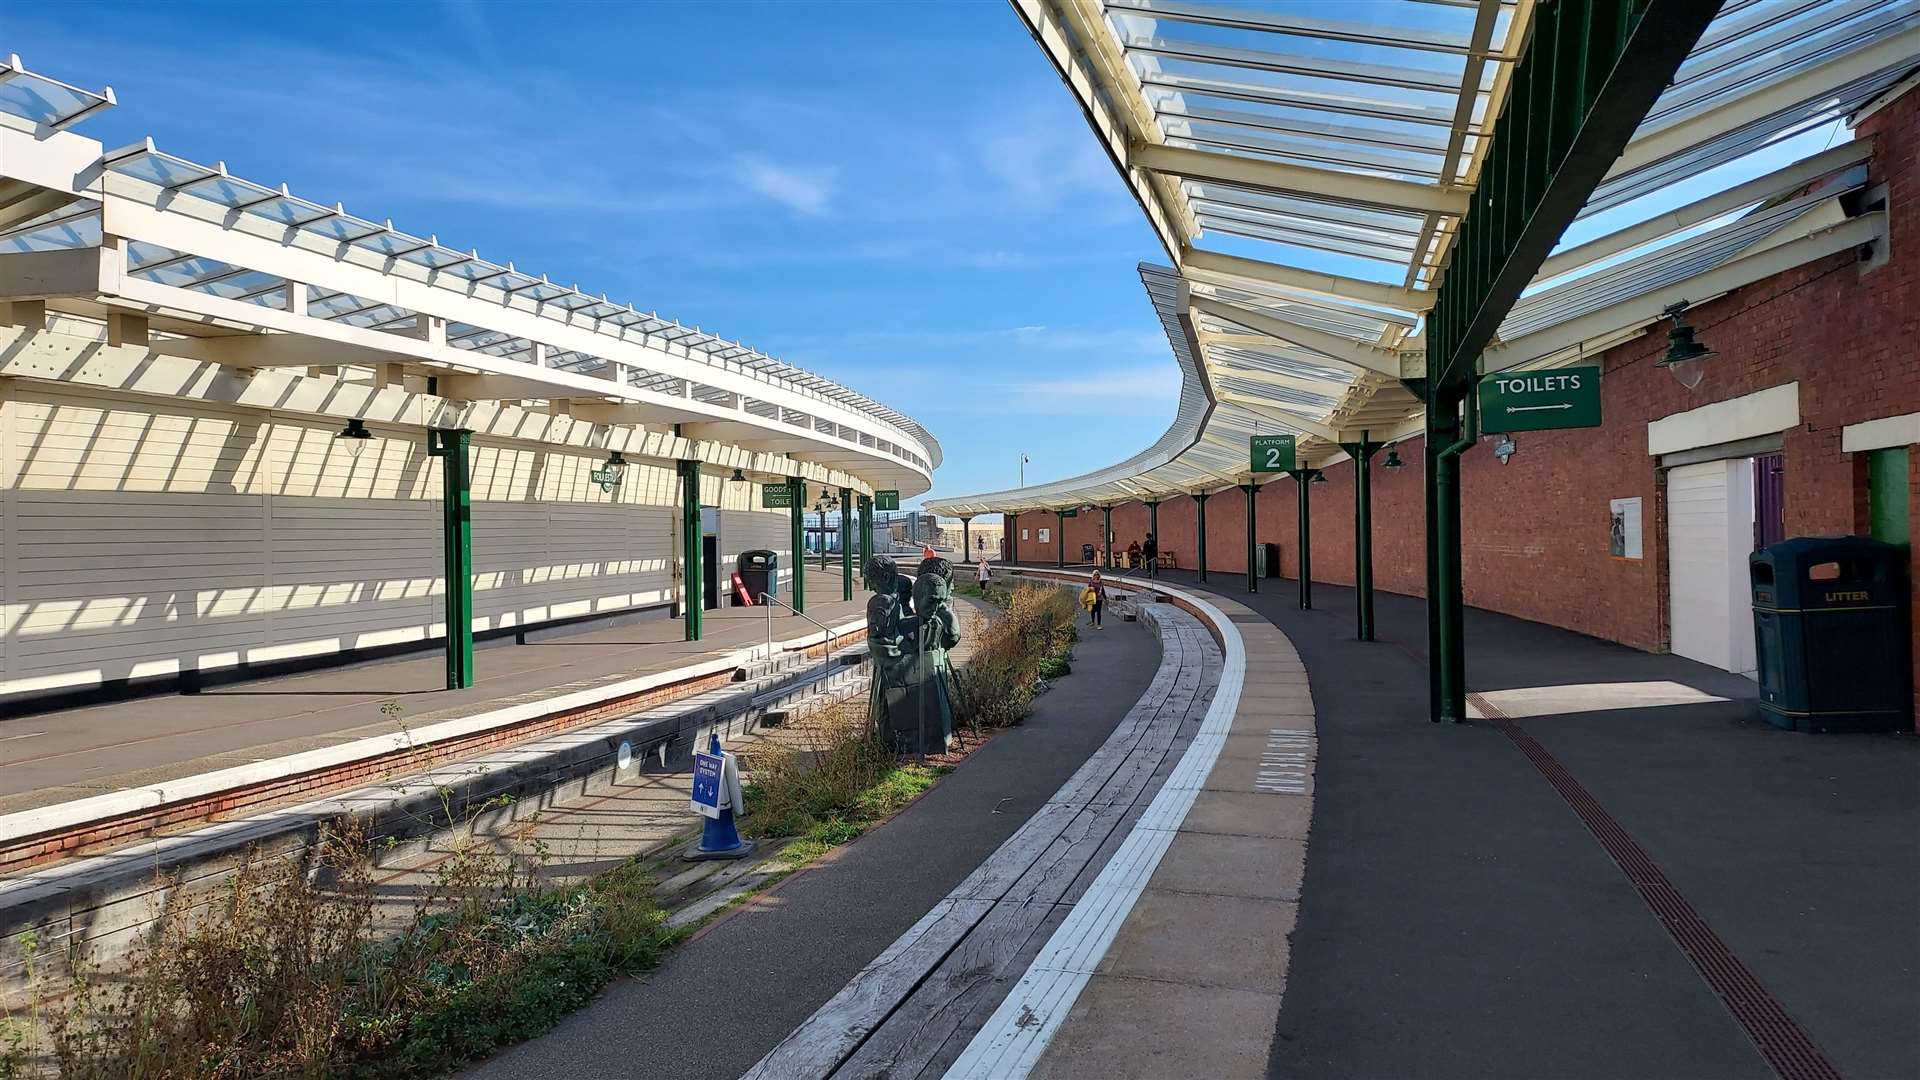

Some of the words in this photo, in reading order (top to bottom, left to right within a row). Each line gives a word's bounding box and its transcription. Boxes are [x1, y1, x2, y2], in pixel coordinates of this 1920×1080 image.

[1496, 375, 1581, 394] TOILETS
[1266, 447, 1280, 468] 2
[1825, 591, 1869, 602] LITTER
[699, 759, 708, 768] ONE
[709, 761, 718, 770] WAY
[699, 767, 716, 778] SYSTEM
